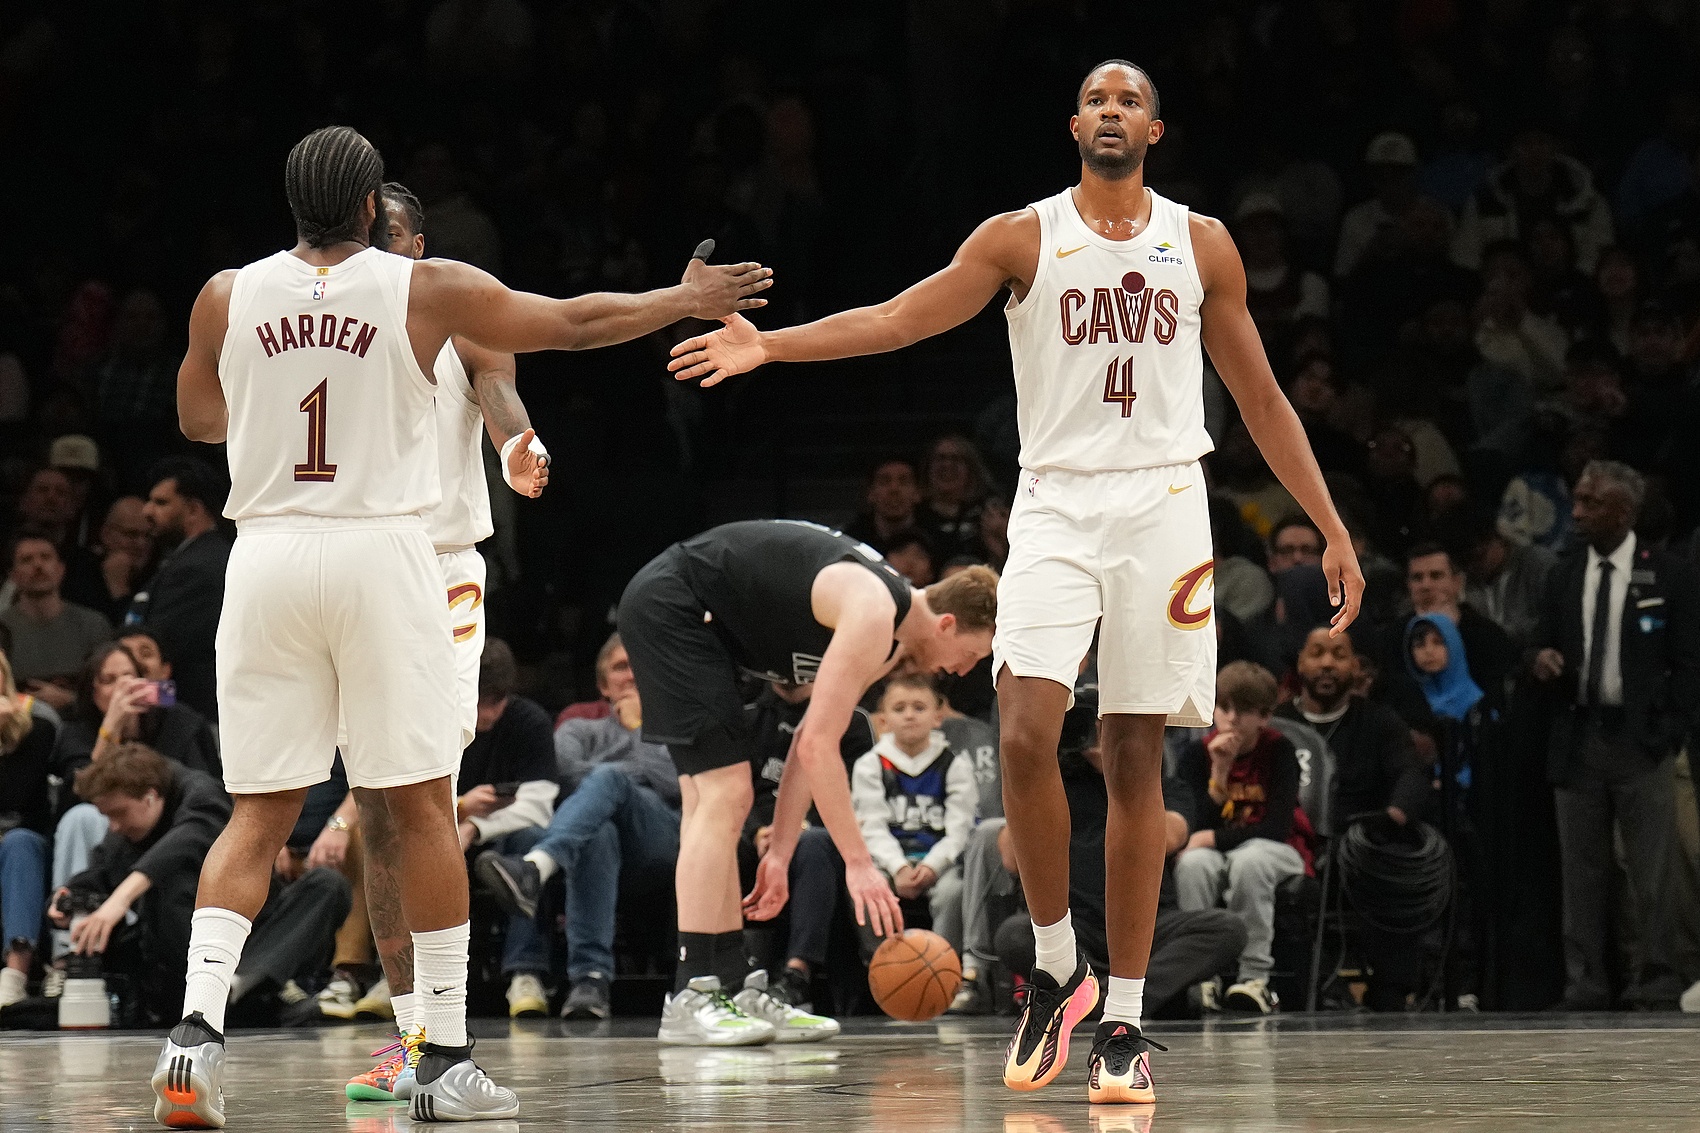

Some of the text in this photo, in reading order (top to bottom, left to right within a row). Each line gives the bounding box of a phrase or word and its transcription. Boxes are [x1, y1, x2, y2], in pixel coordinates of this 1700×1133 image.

[1148, 255, 1183, 265] CLIFFS
[255, 313, 378, 359] HARDEN
[1059, 287, 1179, 346] CAVS
[1103, 355, 1137, 418] 4
[294, 377, 338, 482] 1
